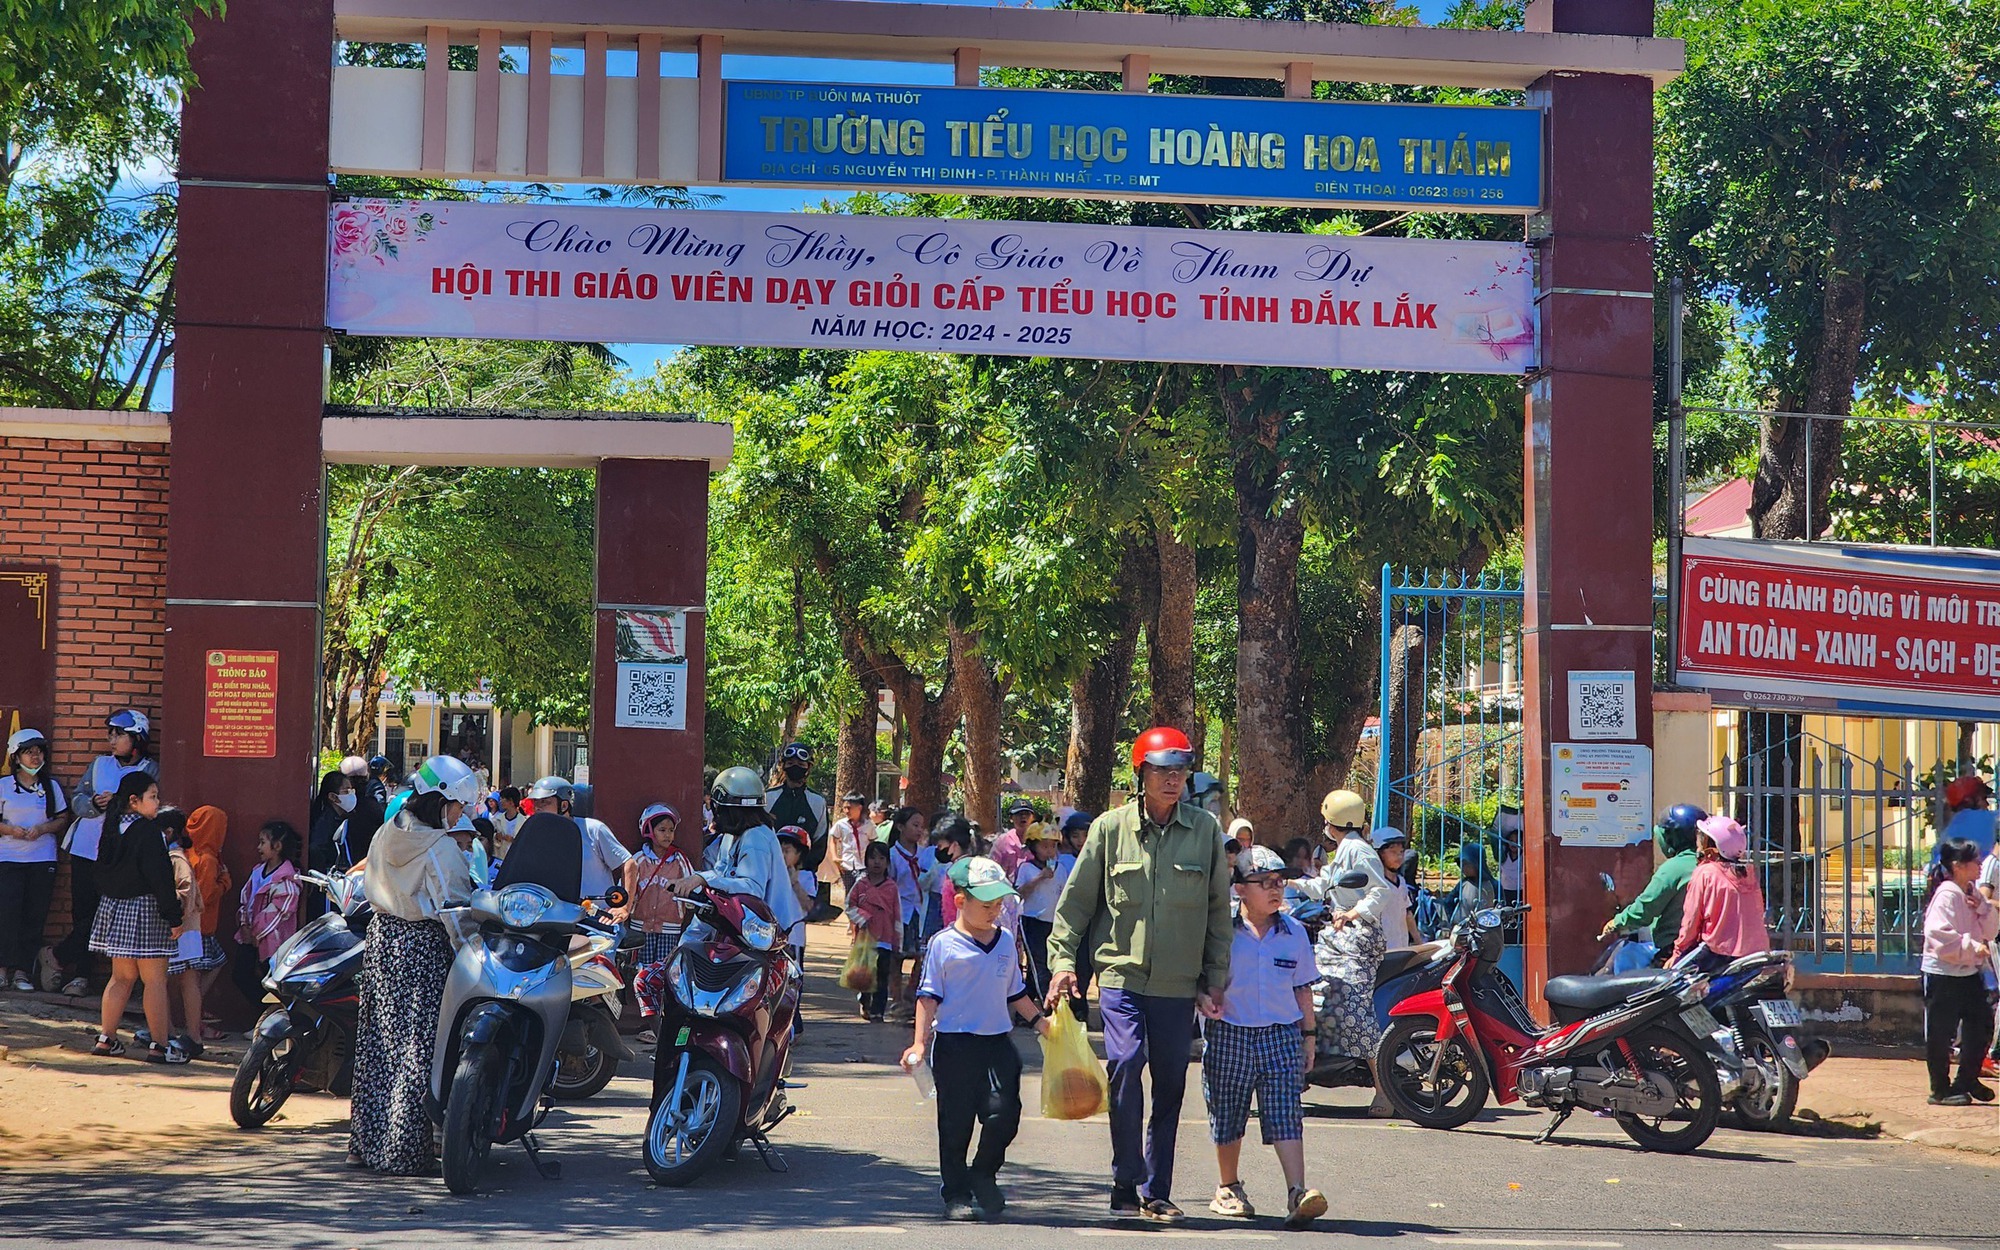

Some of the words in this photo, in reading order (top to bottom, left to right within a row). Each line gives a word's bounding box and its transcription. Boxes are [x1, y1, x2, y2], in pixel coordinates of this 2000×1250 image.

[788, 90, 804, 100] TP
[809, 88, 847, 102] BUÔN
[851, 92, 872, 103] MA
[875, 91, 922, 106] THUỘT
[759, 109, 926, 157] TRƯỜNG
[945, 108, 1033, 159] TIỂU
[1050, 125, 1128, 168] HỌC
[1149, 123, 1286, 169] HOÀNG
[1304, 134, 1382, 173] HOA
[1399, 132, 1512, 178] THÁM
[761, 163, 786, 176] ĐỊA
[845, 161, 907, 177] NGUYỄN
[911, 166, 936, 181] THỊ
[1055, 169, 1092, 184] NHẤT
[1129, 175, 1161, 187] BMT
[1353, 183, 1397, 197] THOẠI
[505, 219, 613, 254] Chào
[627, 223, 746, 268] Mừng
[764, 224, 877, 272] Thầy,
[896, 232, 963, 266] Cô
[974, 233, 1064, 270] Giáo
[1083, 239, 1144, 274] Về
[1170, 241, 1279, 284] Tham
[1294, 244, 1375, 289] Dự
[432, 262, 493, 301] HỘI
[504, 269, 561, 299] THI
[573, 267, 660, 301] GIÁO
[671, 269, 754, 303] VIÊN
[766, 277, 838, 311] DẠY
[849, 273, 921, 309] GIỎI
[933, 275, 1006, 311] CẤP
[1017, 278, 1095, 316] TIỂU
[1106, 290, 1177, 324] HỌC
[1199, 286, 1279, 324] TỈNH
[1289, 289, 1361, 327] ĐẮK
[1373, 292, 1438, 329] LẮK
[811, 314, 867, 337] NĂM
[873, 320, 935, 342] HỌC:
[940, 323, 996, 342] 2024
[1018, 325, 1073, 345] 2025
[1699, 572, 1760, 607] CÙNG
[1766, 579, 1827, 612] HÀNH
[1832, 585, 1894, 621] ĐỘNG
[1900, 590, 1920, 620] VÌ
[1926, 593, 1969, 625] MÔI
[1698, 620, 1733, 655] AN
[1736, 619, 1797, 661] TOÀN
[1815, 629, 1877, 668] XANH
[1895, 637, 1956, 679] SẠCH
[217, 667, 247, 678] THÔNG
[249, 667, 267, 678] BÁO
[1753, 692, 1771, 700] 0262
